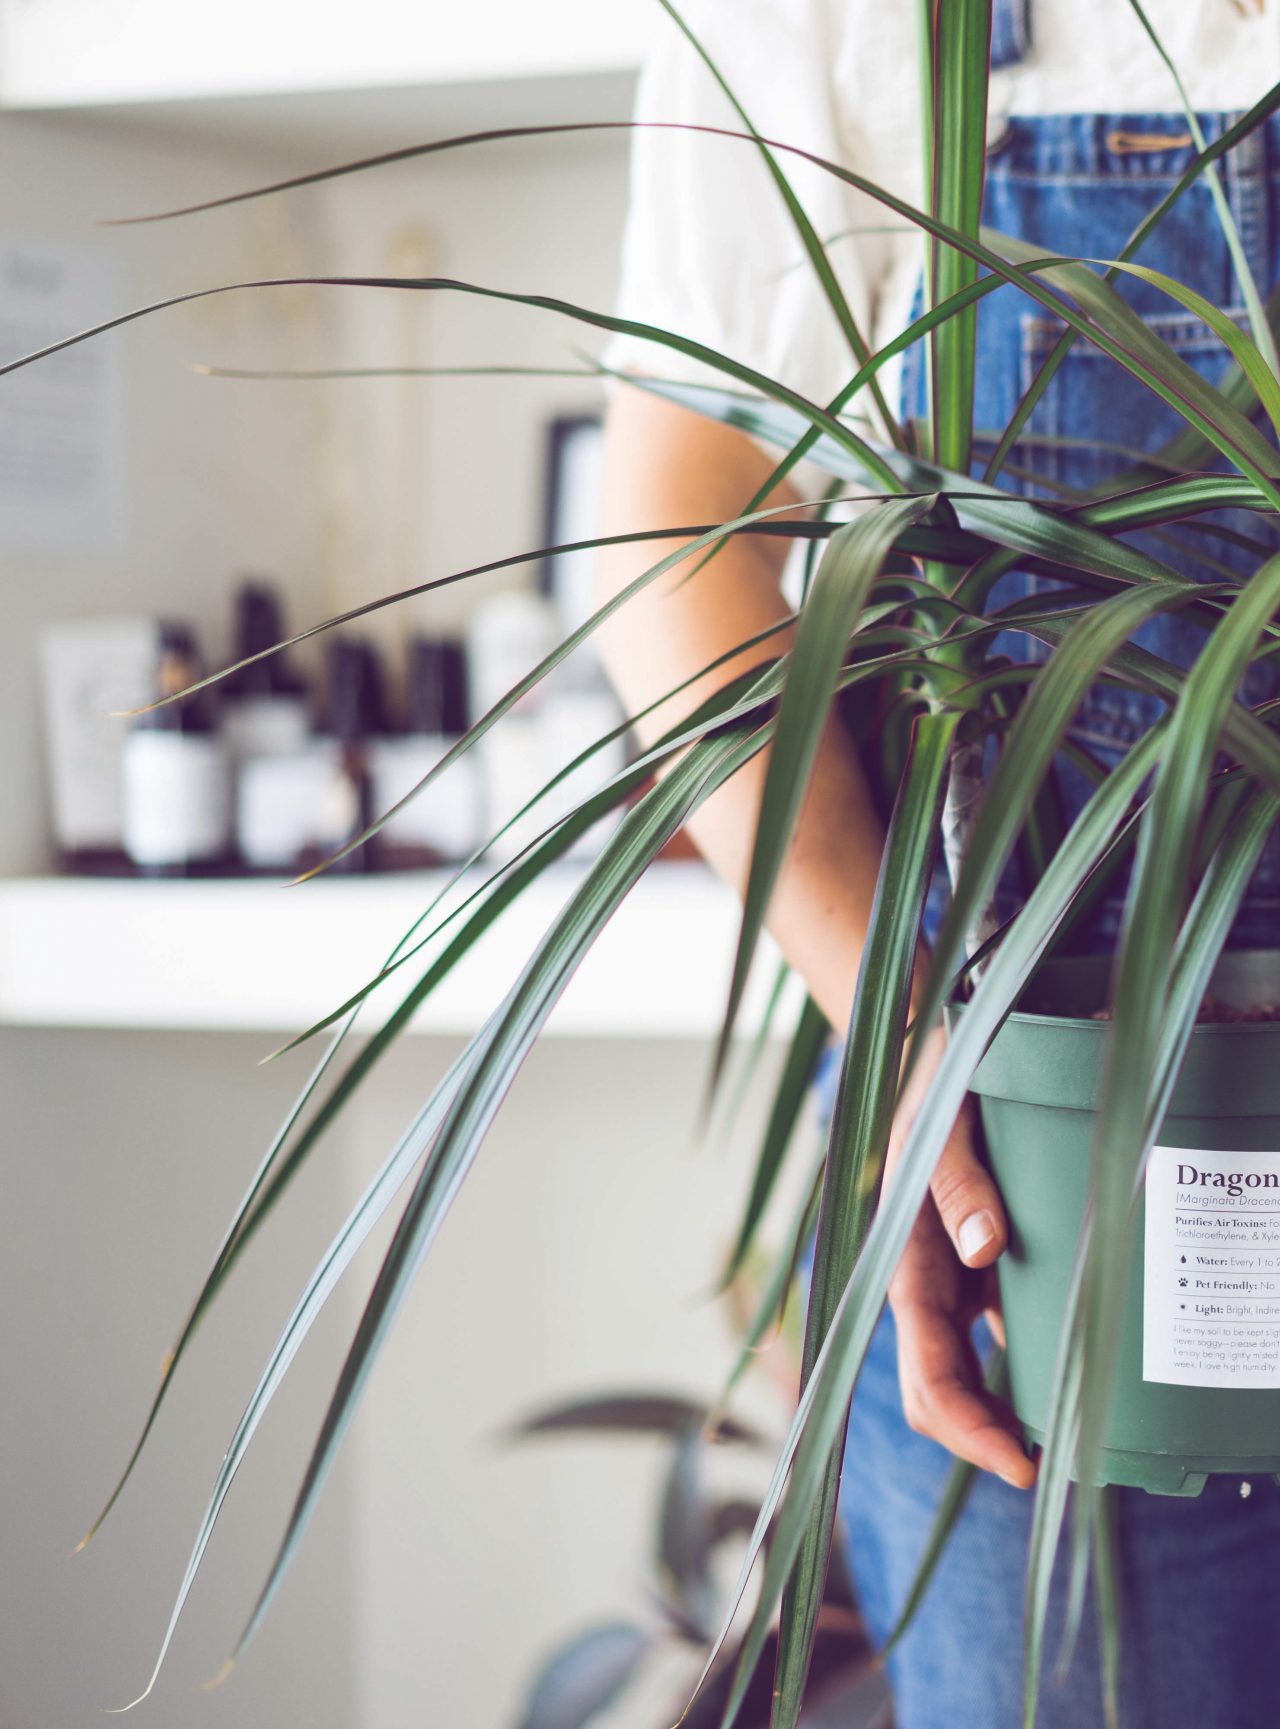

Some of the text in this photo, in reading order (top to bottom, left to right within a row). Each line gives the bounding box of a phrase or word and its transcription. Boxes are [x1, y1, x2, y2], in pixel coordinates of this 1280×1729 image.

[1176, 1164, 1279, 1196] Dragon
[1175, 1192, 1235, 1206] (Marginata
[1175, 1216, 1212, 1227] Purifies
[1214, 1218, 1231, 1227] Air
[1232, 1219, 1267, 1228] Toxins:
[1175, 1228, 1249, 1242] Trichloroethylene,
[1251, 1232, 1259, 1241] &
[1196, 1256, 1228, 1266] Water:
[1230, 1257, 1254, 1268] Every
[1264, 1257, 1274, 1267] to
[1195, 1279, 1275, 1292] Pet Friendly: No
[1195, 1304, 1224, 1316] Light:
[1226, 1305, 1253, 1317] Bright,
[1193, 1327, 1206, 1336] my
[1223, 1328, 1231, 1336] to
[1233, 1327, 1244, 1336] be
